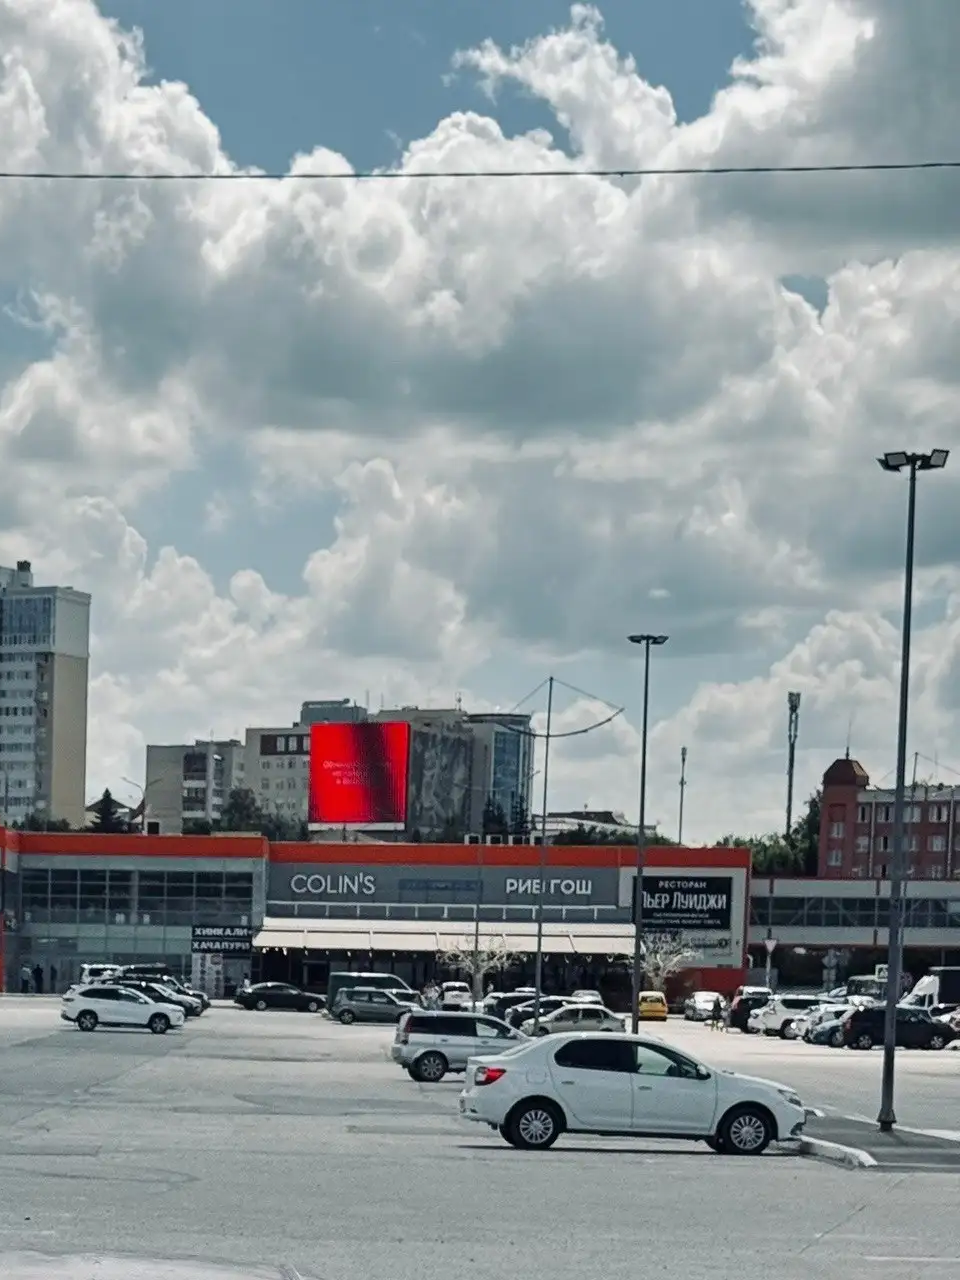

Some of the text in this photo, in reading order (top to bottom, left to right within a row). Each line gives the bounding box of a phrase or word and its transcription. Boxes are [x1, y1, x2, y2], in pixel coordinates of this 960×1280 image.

[290, 872, 376, 895] COLIN'S
[550, 879, 592, 894] ГОШ
[658, 880, 707, 889] РЕСТОРАН
